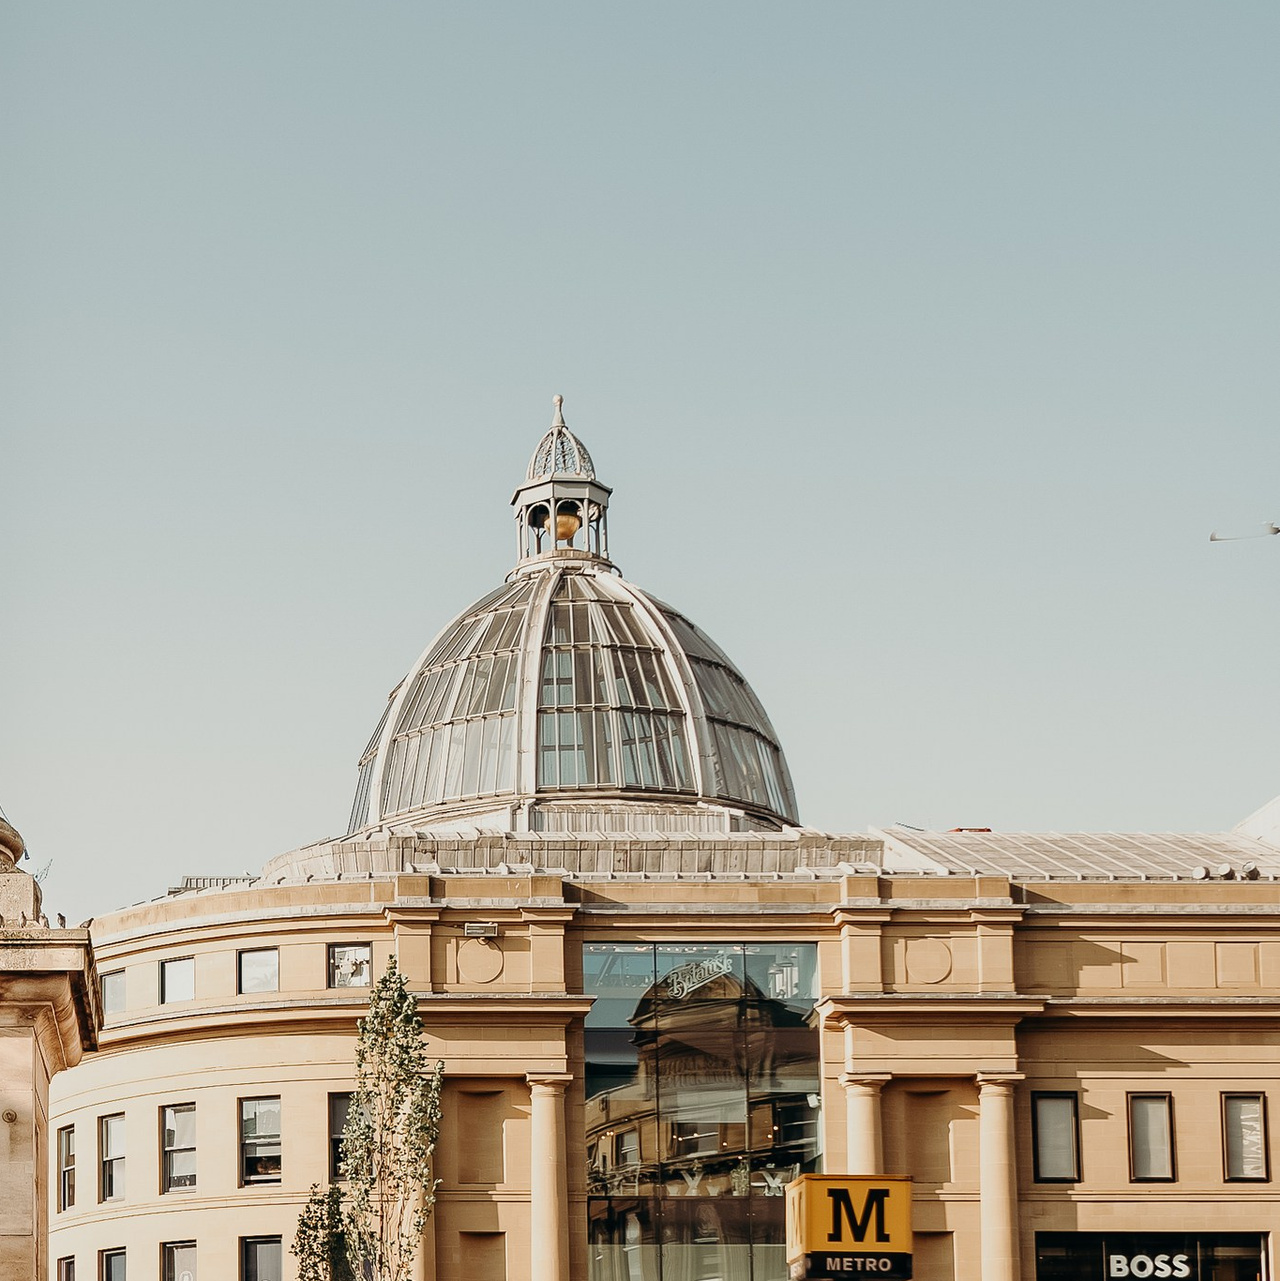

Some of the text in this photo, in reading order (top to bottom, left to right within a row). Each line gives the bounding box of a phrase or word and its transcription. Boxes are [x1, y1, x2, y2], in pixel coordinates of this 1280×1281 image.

[827, 1188, 890, 1243] M
[826, 1257, 892, 1272] METRO
[1109, 1254, 1191, 1278] BOSS
